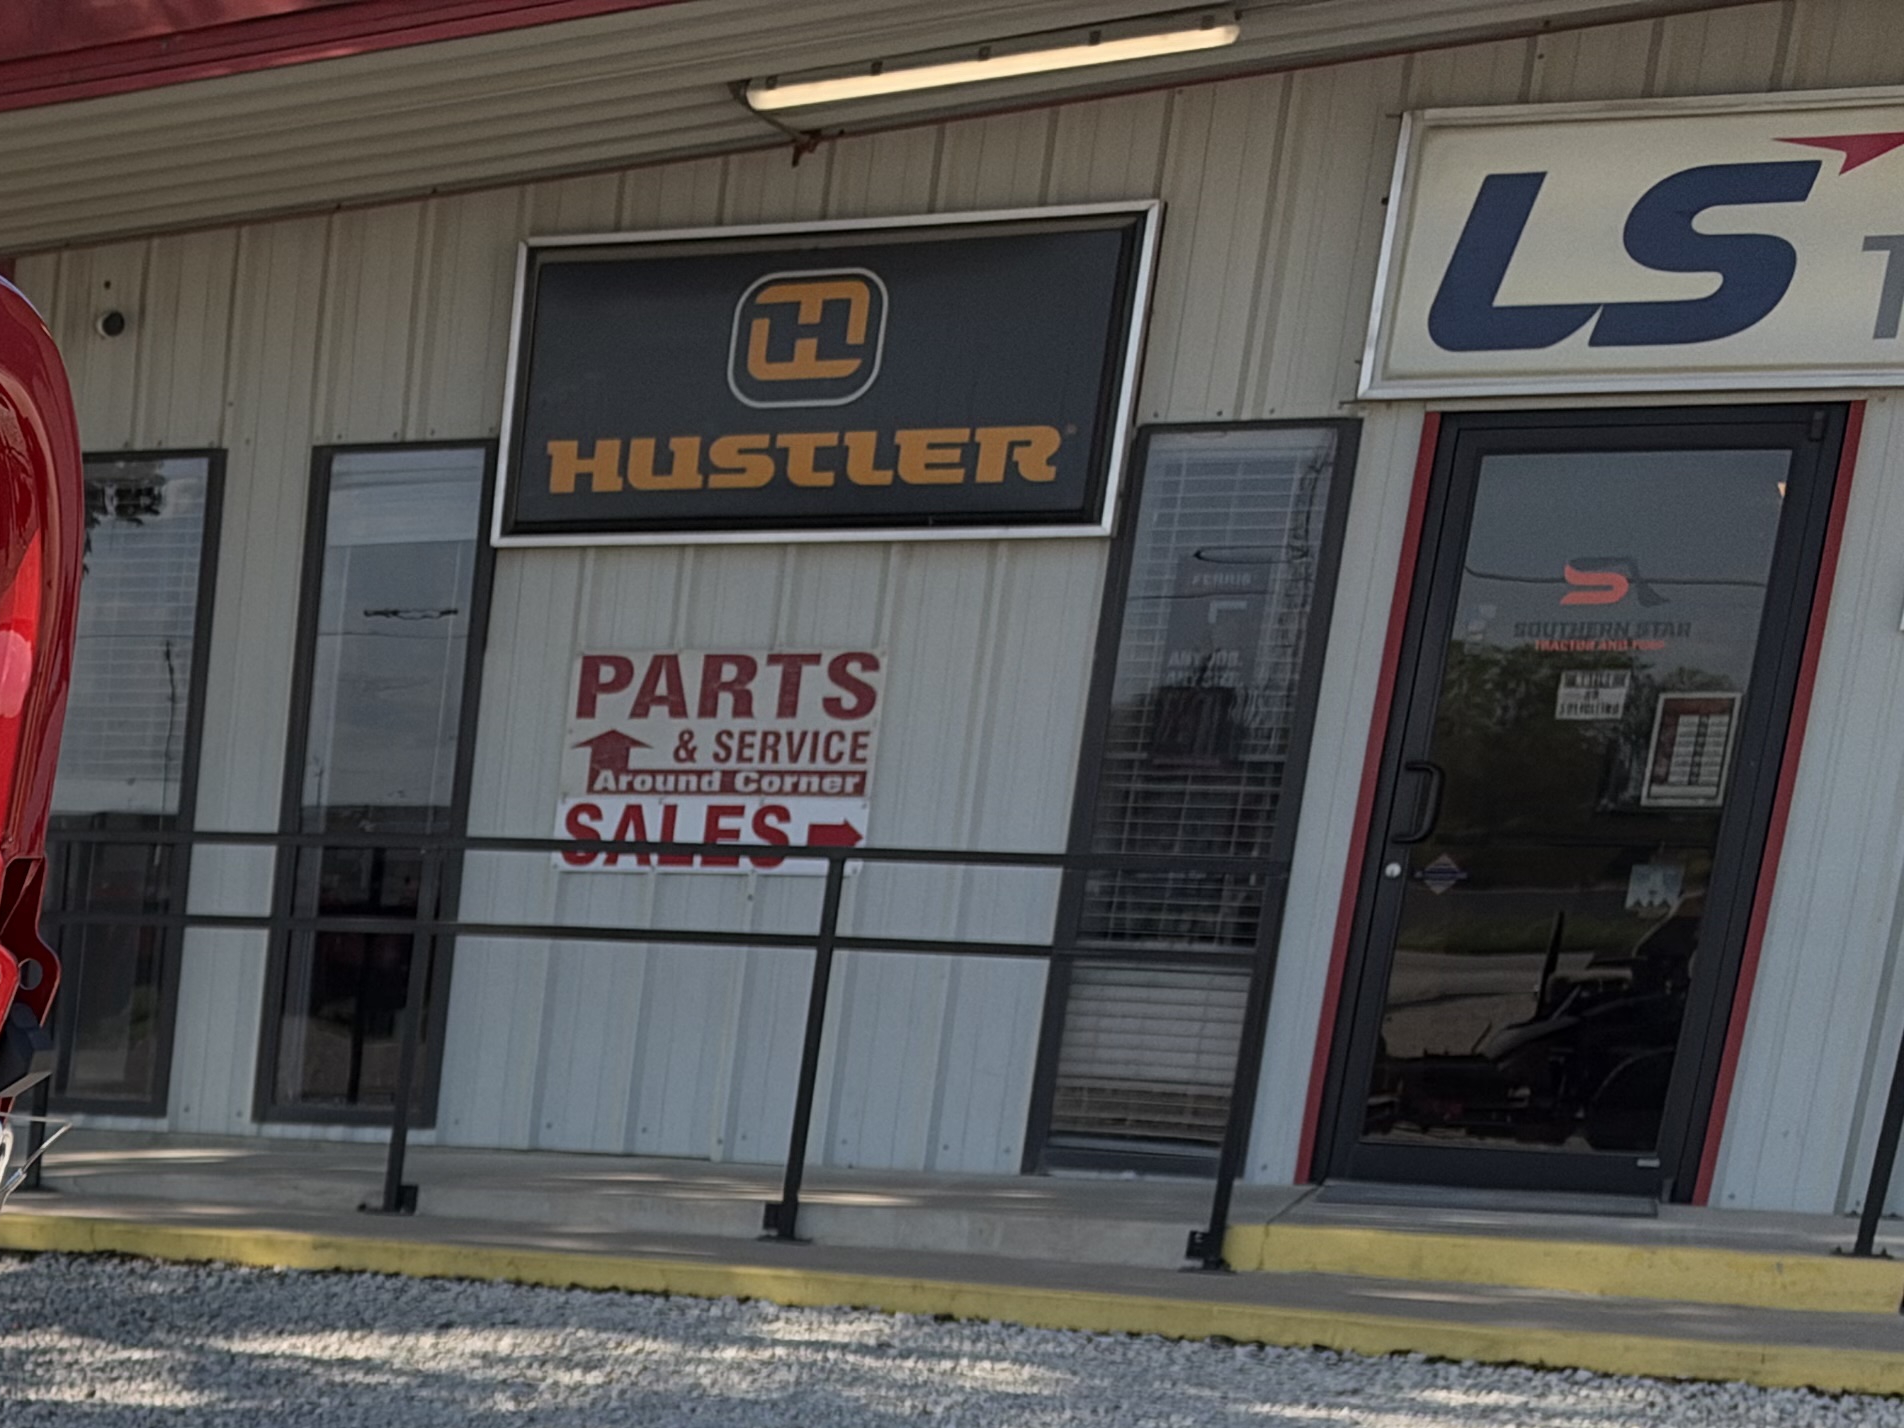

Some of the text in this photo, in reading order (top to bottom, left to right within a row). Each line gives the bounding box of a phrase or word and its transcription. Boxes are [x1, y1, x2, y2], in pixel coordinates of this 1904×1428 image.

[1428, 160, 1822, 352] LS
[547, 425, 1062, 494] HUSTLER
[576, 652, 880, 720] PARTS
[673, 729, 872, 764] & SERVICE
[593, 771, 860, 794] Around Corner
[561, 803, 792, 869] SALES
